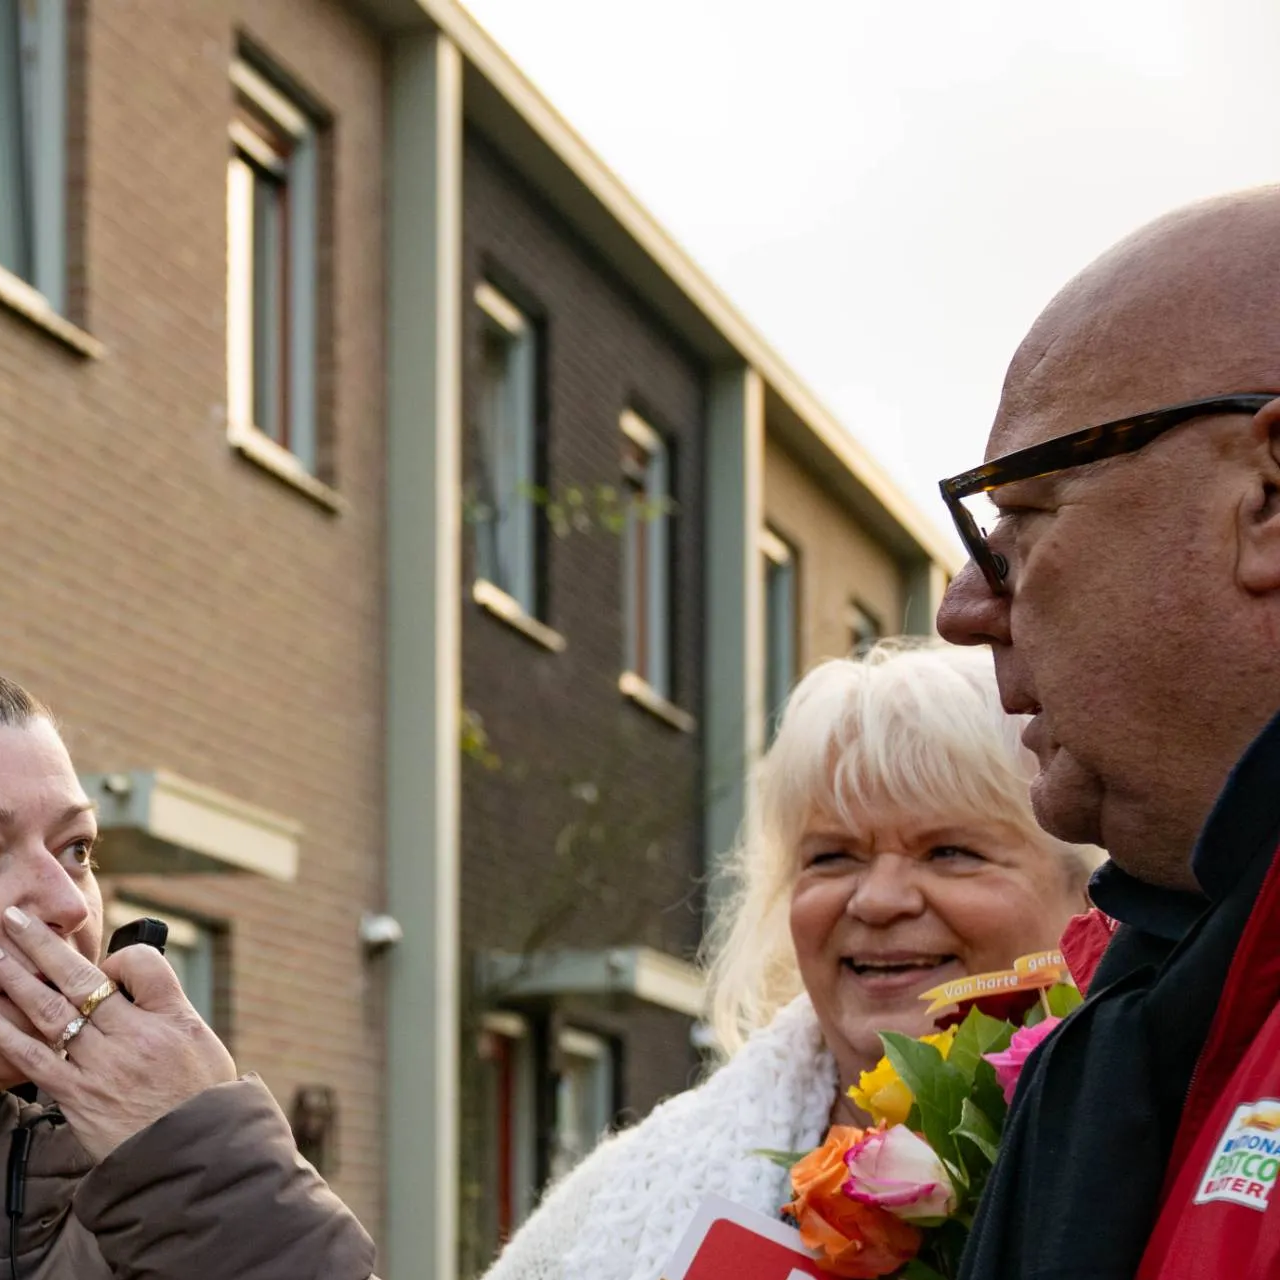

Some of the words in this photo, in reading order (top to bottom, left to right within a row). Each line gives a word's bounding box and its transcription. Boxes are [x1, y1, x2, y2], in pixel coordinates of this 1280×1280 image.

[944, 984, 973, 999] Van
[976, 973, 1019, 991] harte
[1028, 951, 1065, 971] gefe
